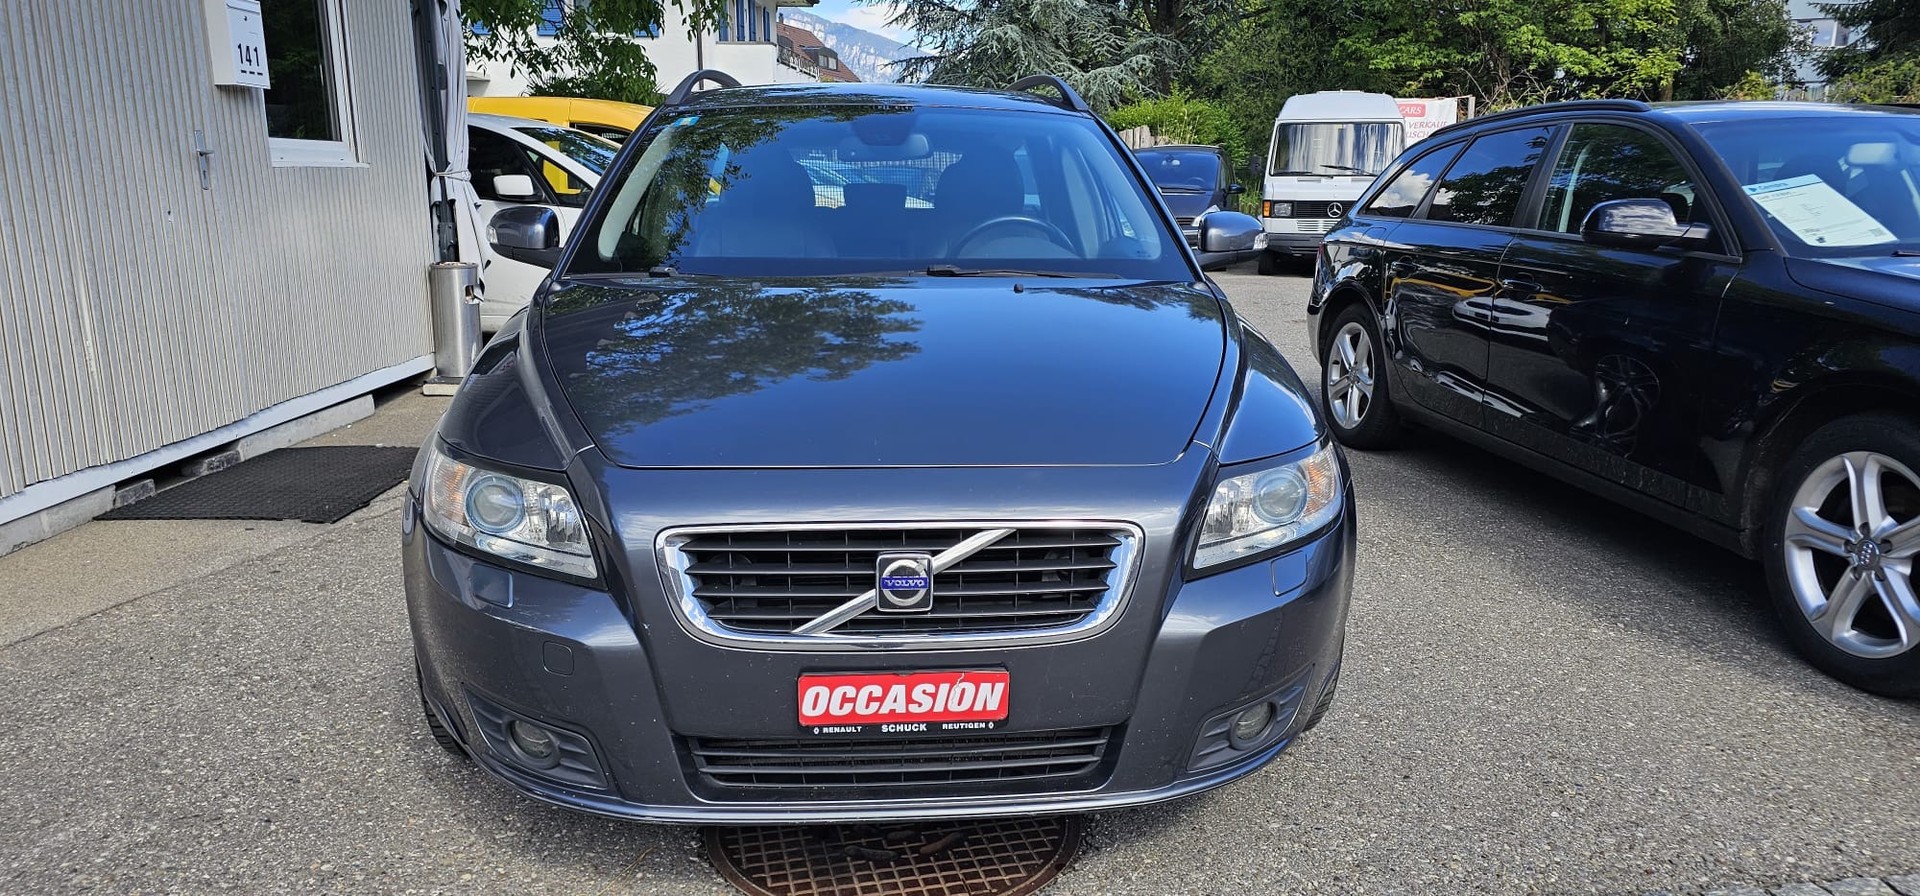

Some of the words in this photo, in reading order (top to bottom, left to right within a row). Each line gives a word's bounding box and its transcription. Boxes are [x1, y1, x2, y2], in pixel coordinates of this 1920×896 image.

[238, 43, 259, 67] 141
[1399, 105, 1422, 115] CARS
[884, 579, 925, 587] VOLVO
[801, 682, 1005, 717] OCCASION
[822, 725, 862, 734] RENAULT
[881, 722, 927, 733] SCHUCK
[942, 721, 986, 730] REUTIGEN
